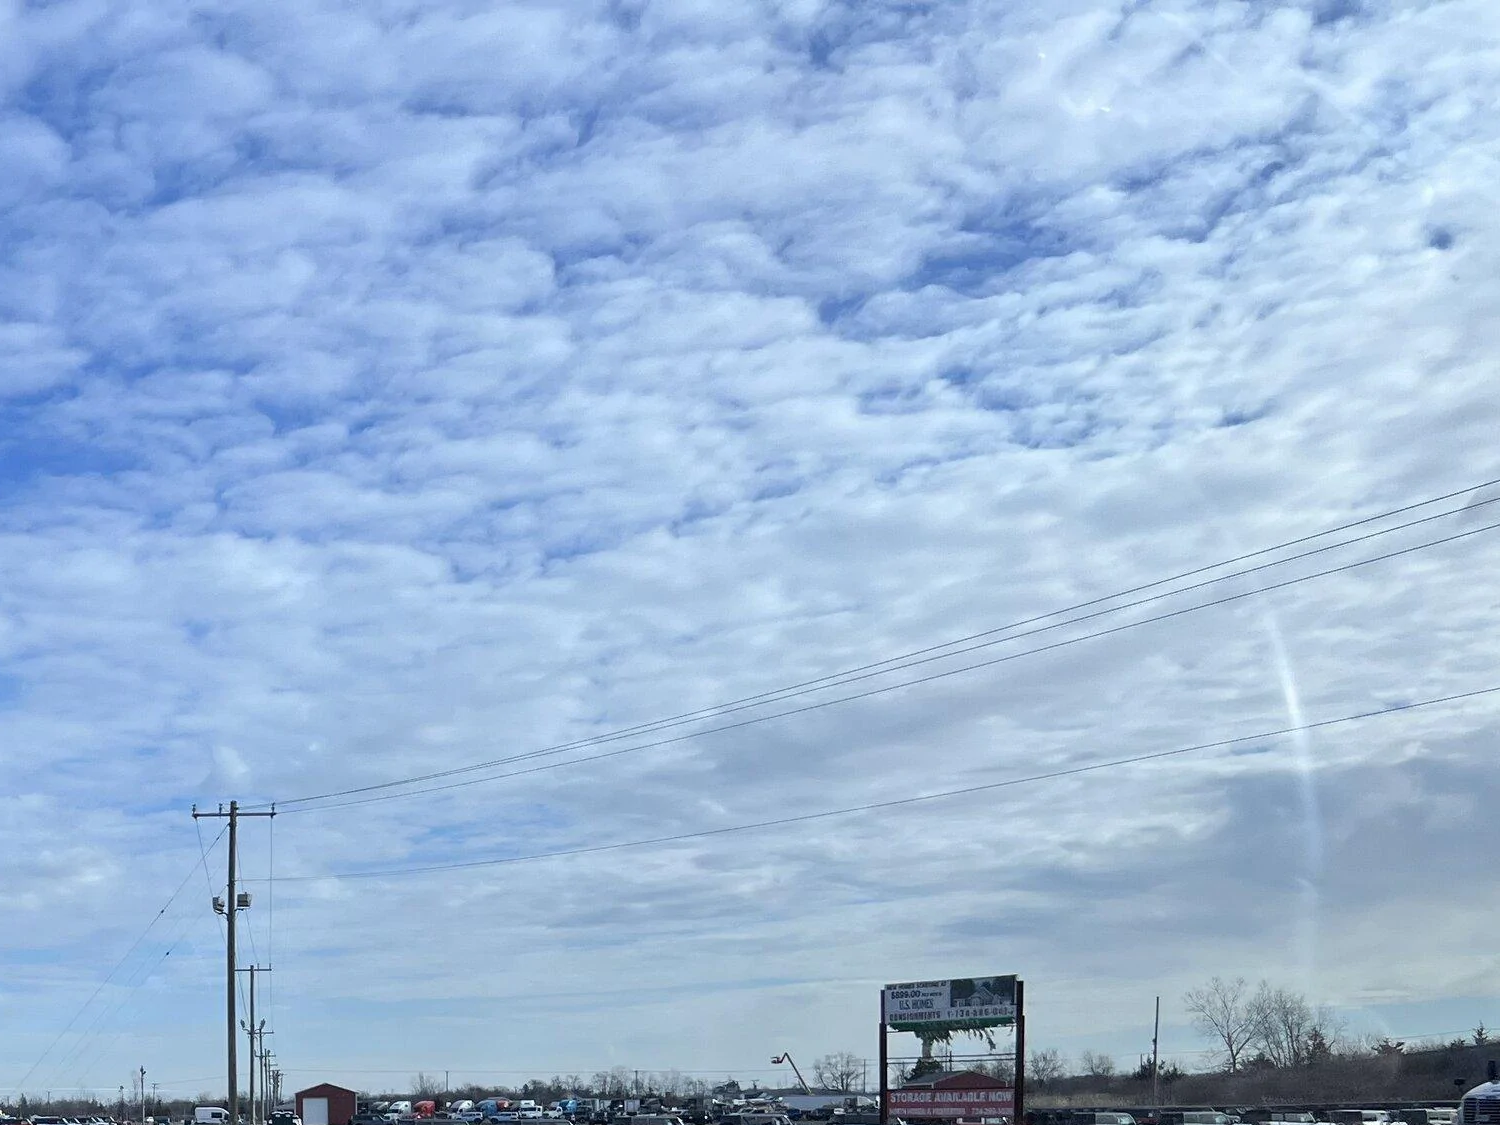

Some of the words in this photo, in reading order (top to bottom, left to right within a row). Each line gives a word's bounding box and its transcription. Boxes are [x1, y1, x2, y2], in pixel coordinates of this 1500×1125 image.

[911, 999, 934, 1009] HOMES
[890, 1092, 932, 1103] STORAGE
[934, 1091, 987, 1102] AVAILABLE
[989, 1091, 1012, 1102] NOW
